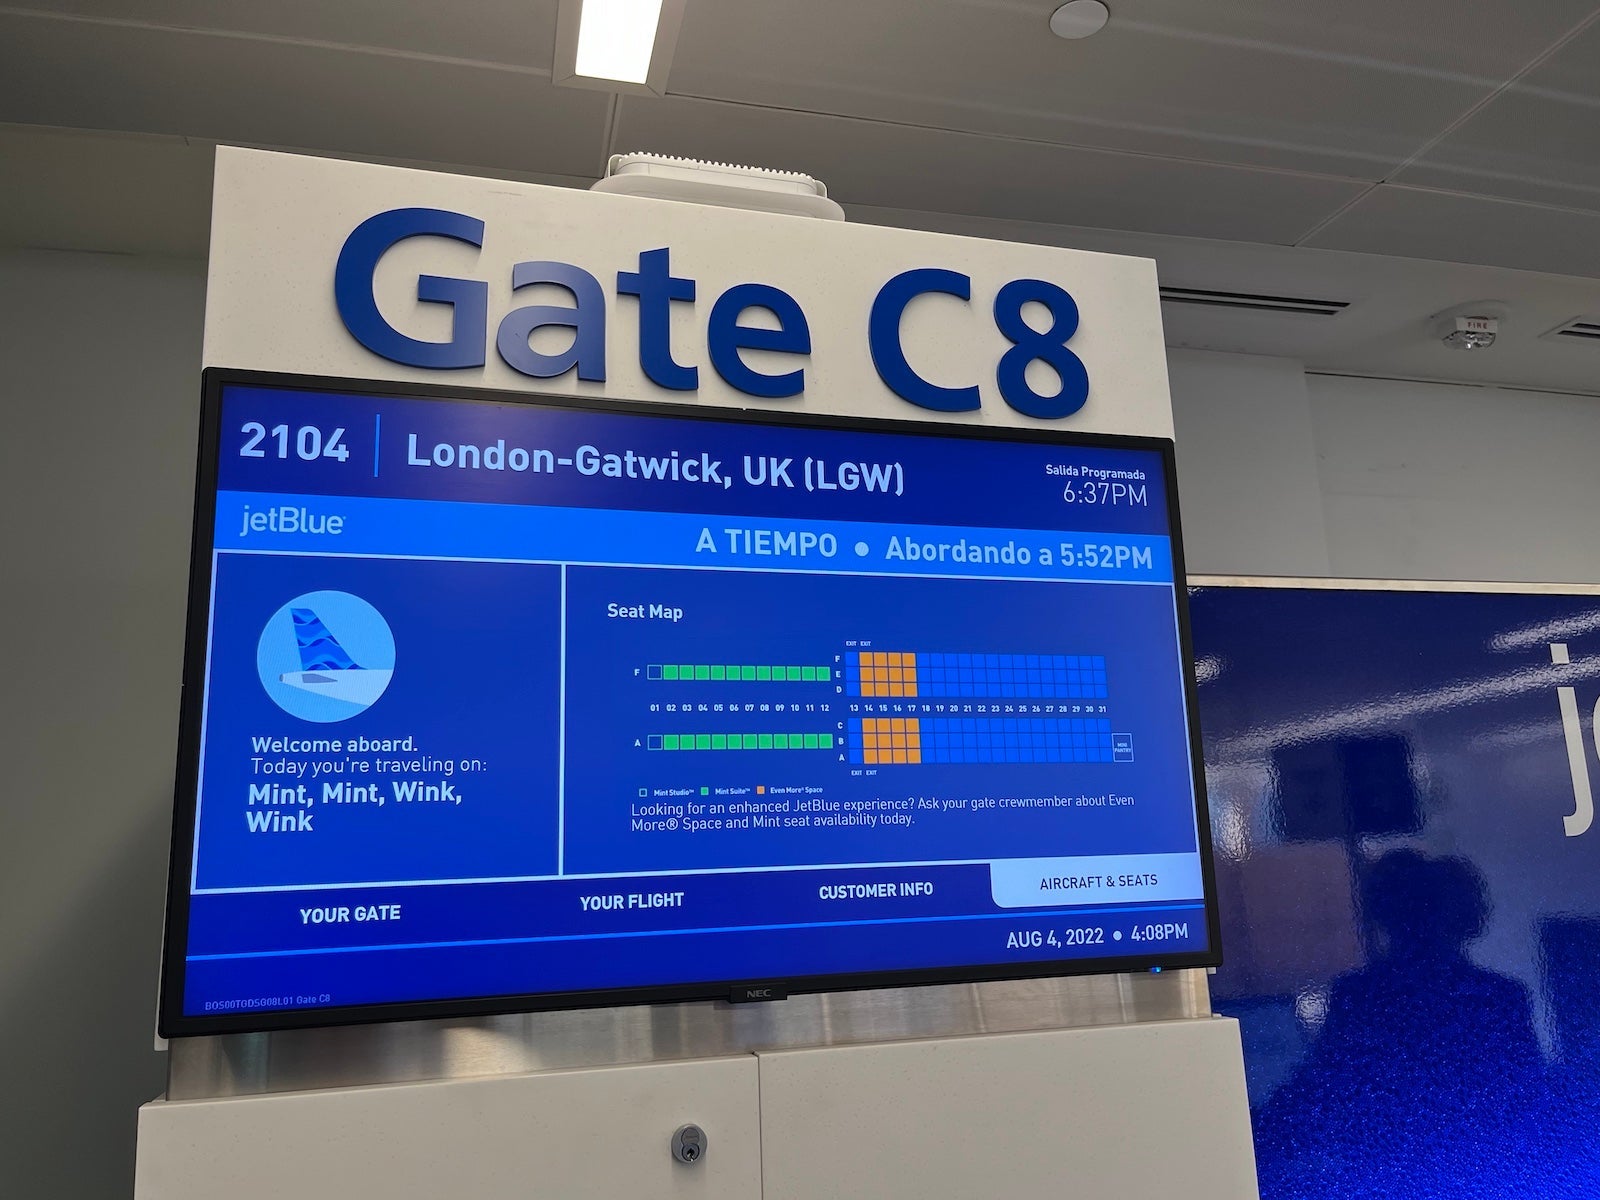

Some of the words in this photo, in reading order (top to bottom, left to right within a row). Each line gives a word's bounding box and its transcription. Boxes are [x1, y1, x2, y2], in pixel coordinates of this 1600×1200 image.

[334, 206, 812, 398] Gate
[868, 267, 1090, 420] C8
[1467, 322, 1488, 330] FIRE
[240, 422, 349, 462] 2104
[408, 433, 731, 489] London-Gatwick,
[744, 456, 794, 487] UK
[805, 457, 903, 496] (LGW)
[1046, 464, 1078, 476] Salida
[1082, 466, 1145, 480] Programada
[1064, 481, 1147, 506] 6:37PM
[696, 528, 717, 552] A
[725, 529, 837, 557] TIEMPO
[886, 536, 1030, 564] Abordando
[1039, 548, 1052, 565] a
[1061, 543, 1152, 569] 5:52PM
[608, 603, 644, 618] Seat
[650, 604, 682, 622] Map
[835, 670, 841, 678] E
[252, 737, 342, 753] Welcome
[348, 736, 417, 752] aboard.
[1549, 643, 1600, 837] j
[251, 758, 307, 778] Today
[312, 757, 369, 778] you're
[376, 756, 453, 776] traveling
[461, 760, 486, 771] on:
[249, 784, 313, 808] Mint,
[323, 782, 384, 806] Mint,
[392, 781, 461, 805] Wink,
[654, 789, 668, 797] Mint
[805, 787, 824, 795] Space
[632, 803, 684, 817] Looking
[688, 802, 706, 814] for
[710, 805, 724, 814] an
[729, 800, 789, 813] enhanced
[794, 799, 839, 811] JetBlue
[843, 797, 915, 813] experience?
[918, 797, 939, 809] Ask
[942, 800, 968, 811] your
[971, 798, 995, 811] gate
[999, 796, 1071, 807] crewmember
[1075, 795, 1106, 807] about
[1109, 794, 1134, 805] Even
[246, 810, 313, 832] Wink
[683, 816, 722, 832] Space
[726, 814, 748, 828] and
[753, 815, 780, 827] Mint
[784, 816, 810, 827] seat
[814, 811, 877, 827] availability
[880, 812, 915, 827] today.
[820, 884, 897, 899] CUSTOMER
[900, 882, 933, 896] INFO
[1040, 876, 1102, 890] AIRCRAFT
[1107, 876, 1115, 887] &
[1119, 874, 1157, 886] SEATS
[580, 895, 624, 911] YOUR
[629, 892, 684, 908] FLIGHT
[300, 907, 349, 924] YOUR
[355, 905, 401, 921] GATE
[1007, 931, 1042, 948] AUG
[1047, 930, 1062, 949] 4,
[1066, 928, 1104, 945] 2022
[1131, 923, 1189, 943] 4:08PM
[297, 996, 316, 1004] Gate
[319, 994, 330, 1002] C8
[747, 989, 771, 998] NEC
